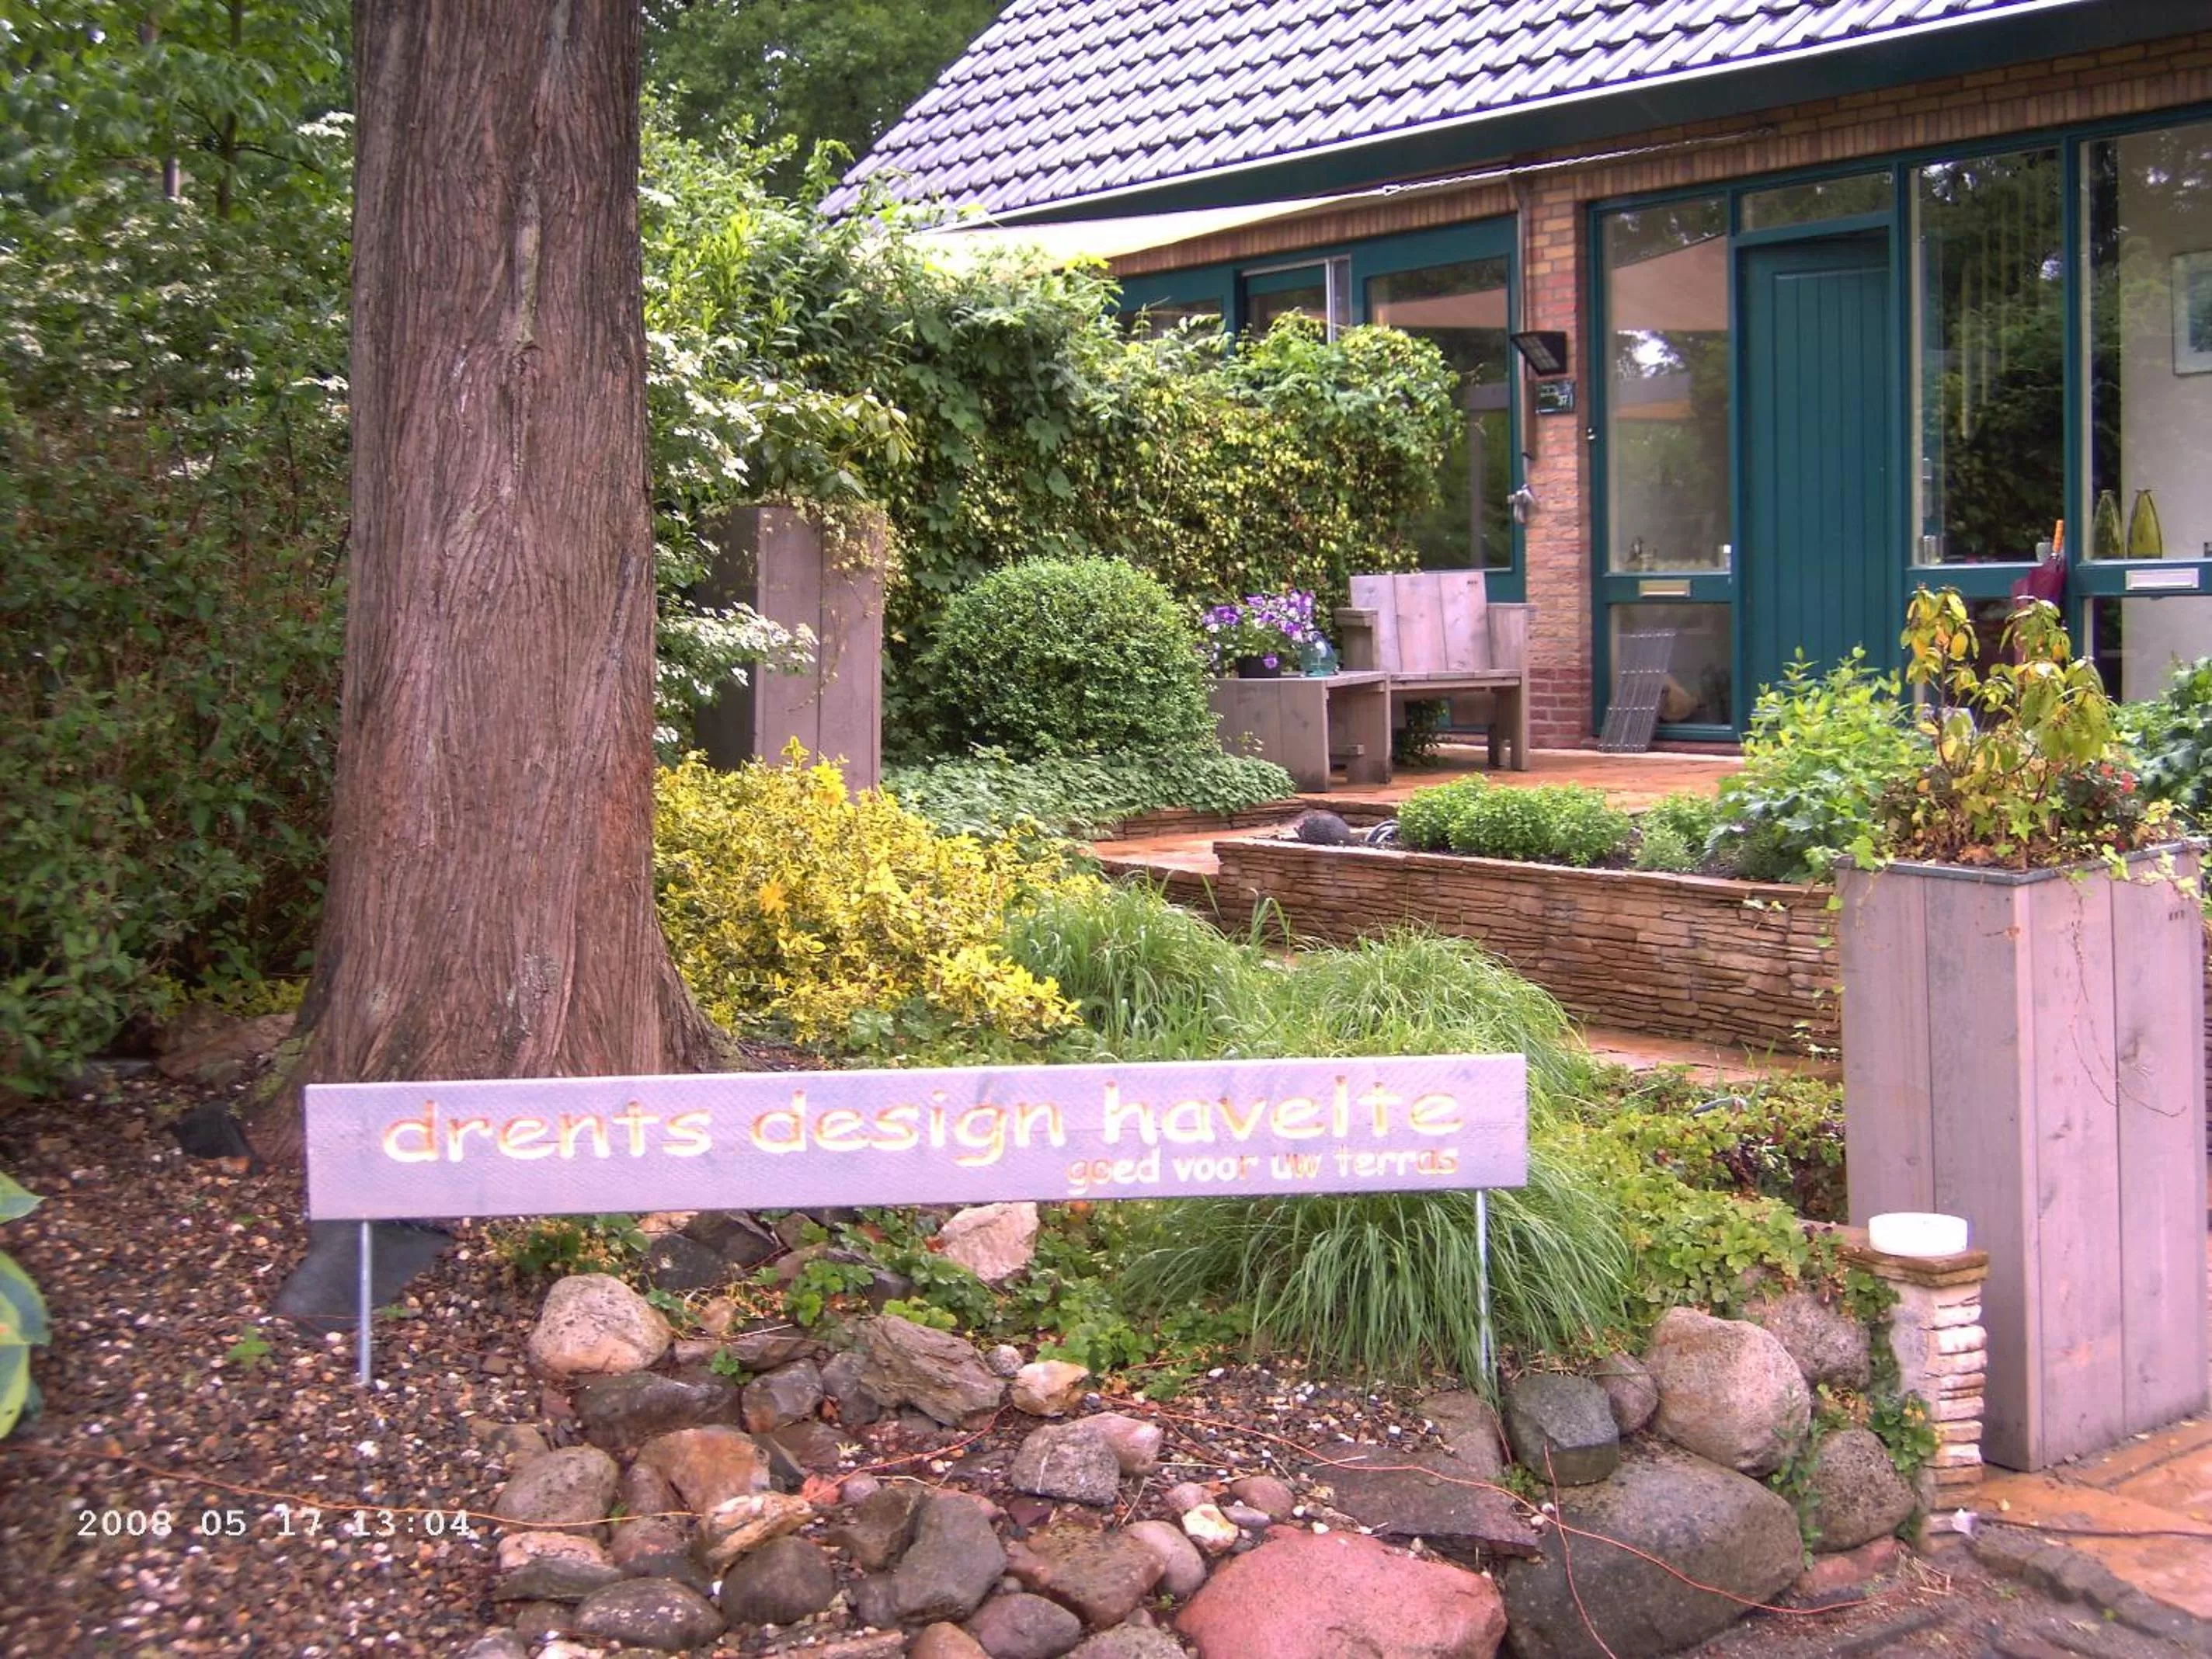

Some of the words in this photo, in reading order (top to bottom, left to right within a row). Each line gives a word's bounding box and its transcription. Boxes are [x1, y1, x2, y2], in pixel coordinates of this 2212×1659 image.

[382, 1099, 713, 1162] drents
[750, 1088, 1068, 1168] design
[1102, 1075, 1465, 1146] havelte
[1172, 1155, 1258, 1182] voor
[1270, 1153, 1322, 1180] uw
[1333, 1144, 1460, 1178] terras
